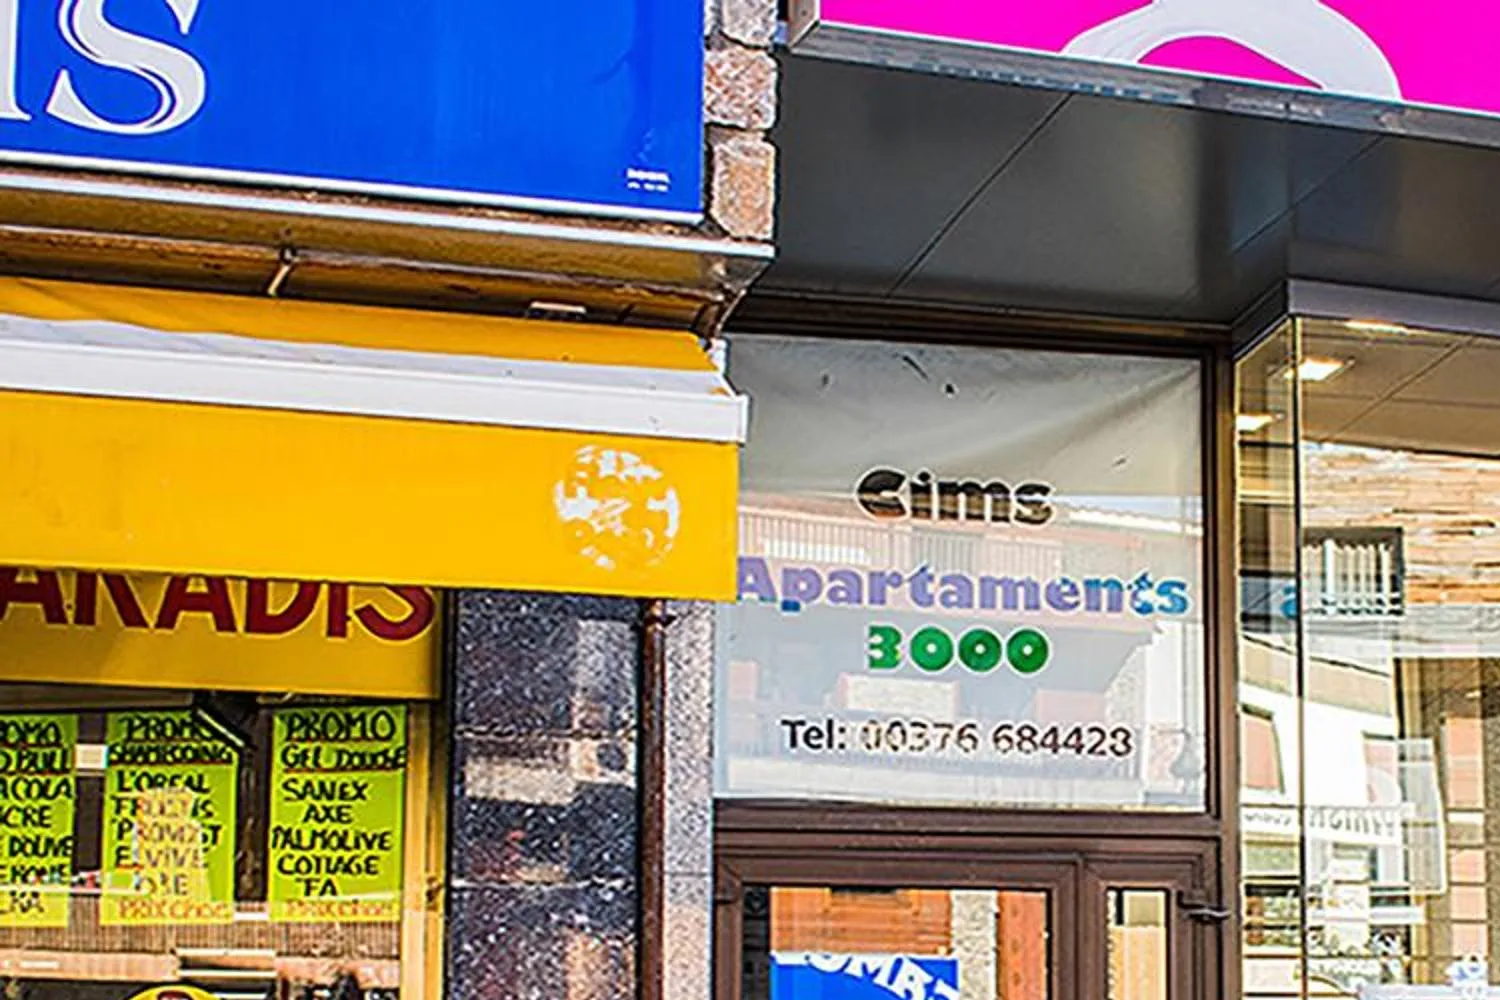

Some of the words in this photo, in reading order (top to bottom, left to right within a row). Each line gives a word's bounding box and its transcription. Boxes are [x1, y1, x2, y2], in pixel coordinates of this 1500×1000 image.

[858, 469, 1053, 525] Cims
[737, 557, 1189, 613] Apartaments
[868, 628, 1050, 673] 3000
[780, 718, 846, 751] Tel:
[861, 720, 978, 753] 00376
[282, 778, 368, 801] SANEX
[302, 804, 353, 825] AXE
